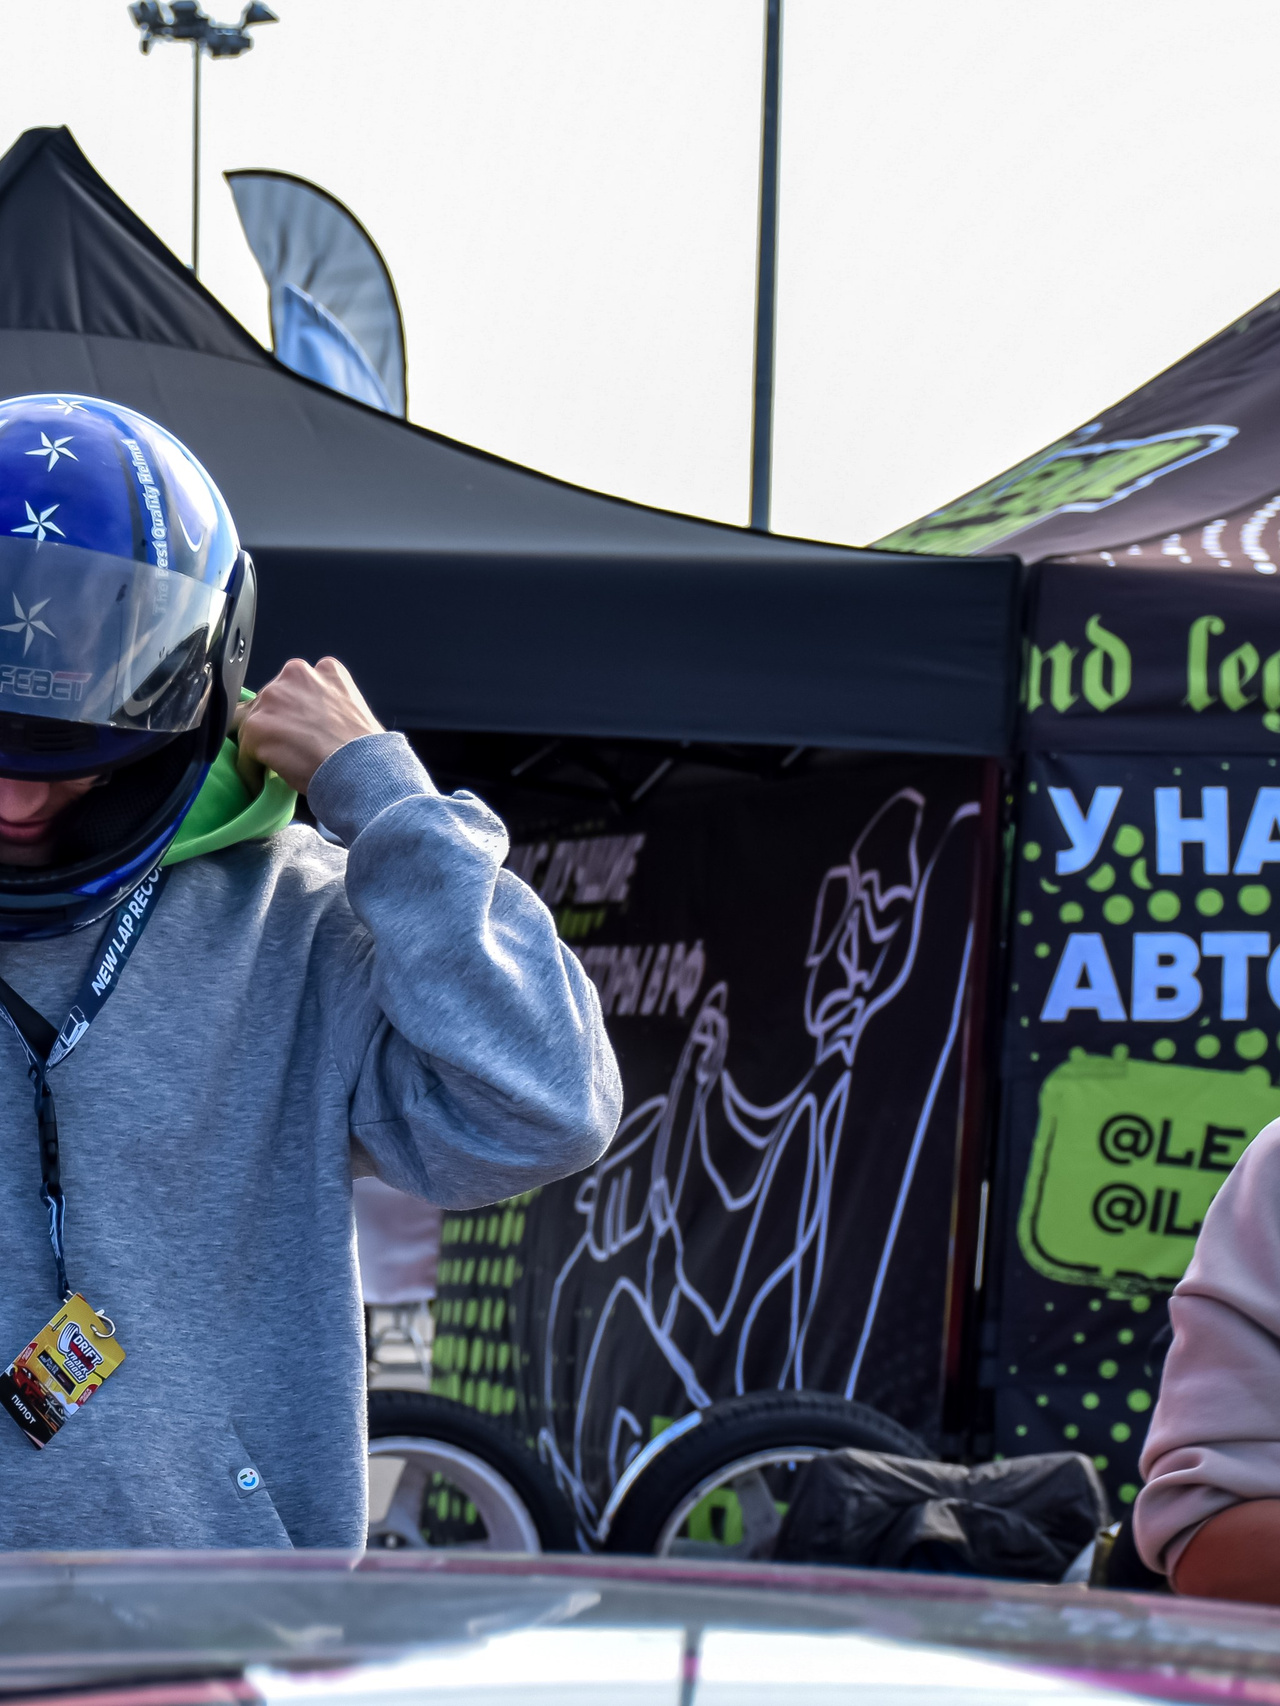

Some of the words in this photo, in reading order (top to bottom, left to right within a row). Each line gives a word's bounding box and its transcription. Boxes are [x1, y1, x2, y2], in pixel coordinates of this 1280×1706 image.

[121, 438, 155, 485] Helmet
[142, 484, 167, 540] Quality
[151, 540, 169, 580] Best
[152, 581, 168, 615] The
[1047, 786, 1123, 875] У
[91, 945, 119, 997] NEW
[111, 913, 135, 954] LAP
[128, 866, 162, 920] RECO
[1039, 932, 1280, 1022] АВТ
[1090, 1183, 1216, 1237] @IL
[67, 1350, 89, 1375] TRACK
[73, 1334, 101, 1364] DRIFT
[11, 1394, 37, 1425] ПИЛОТ
